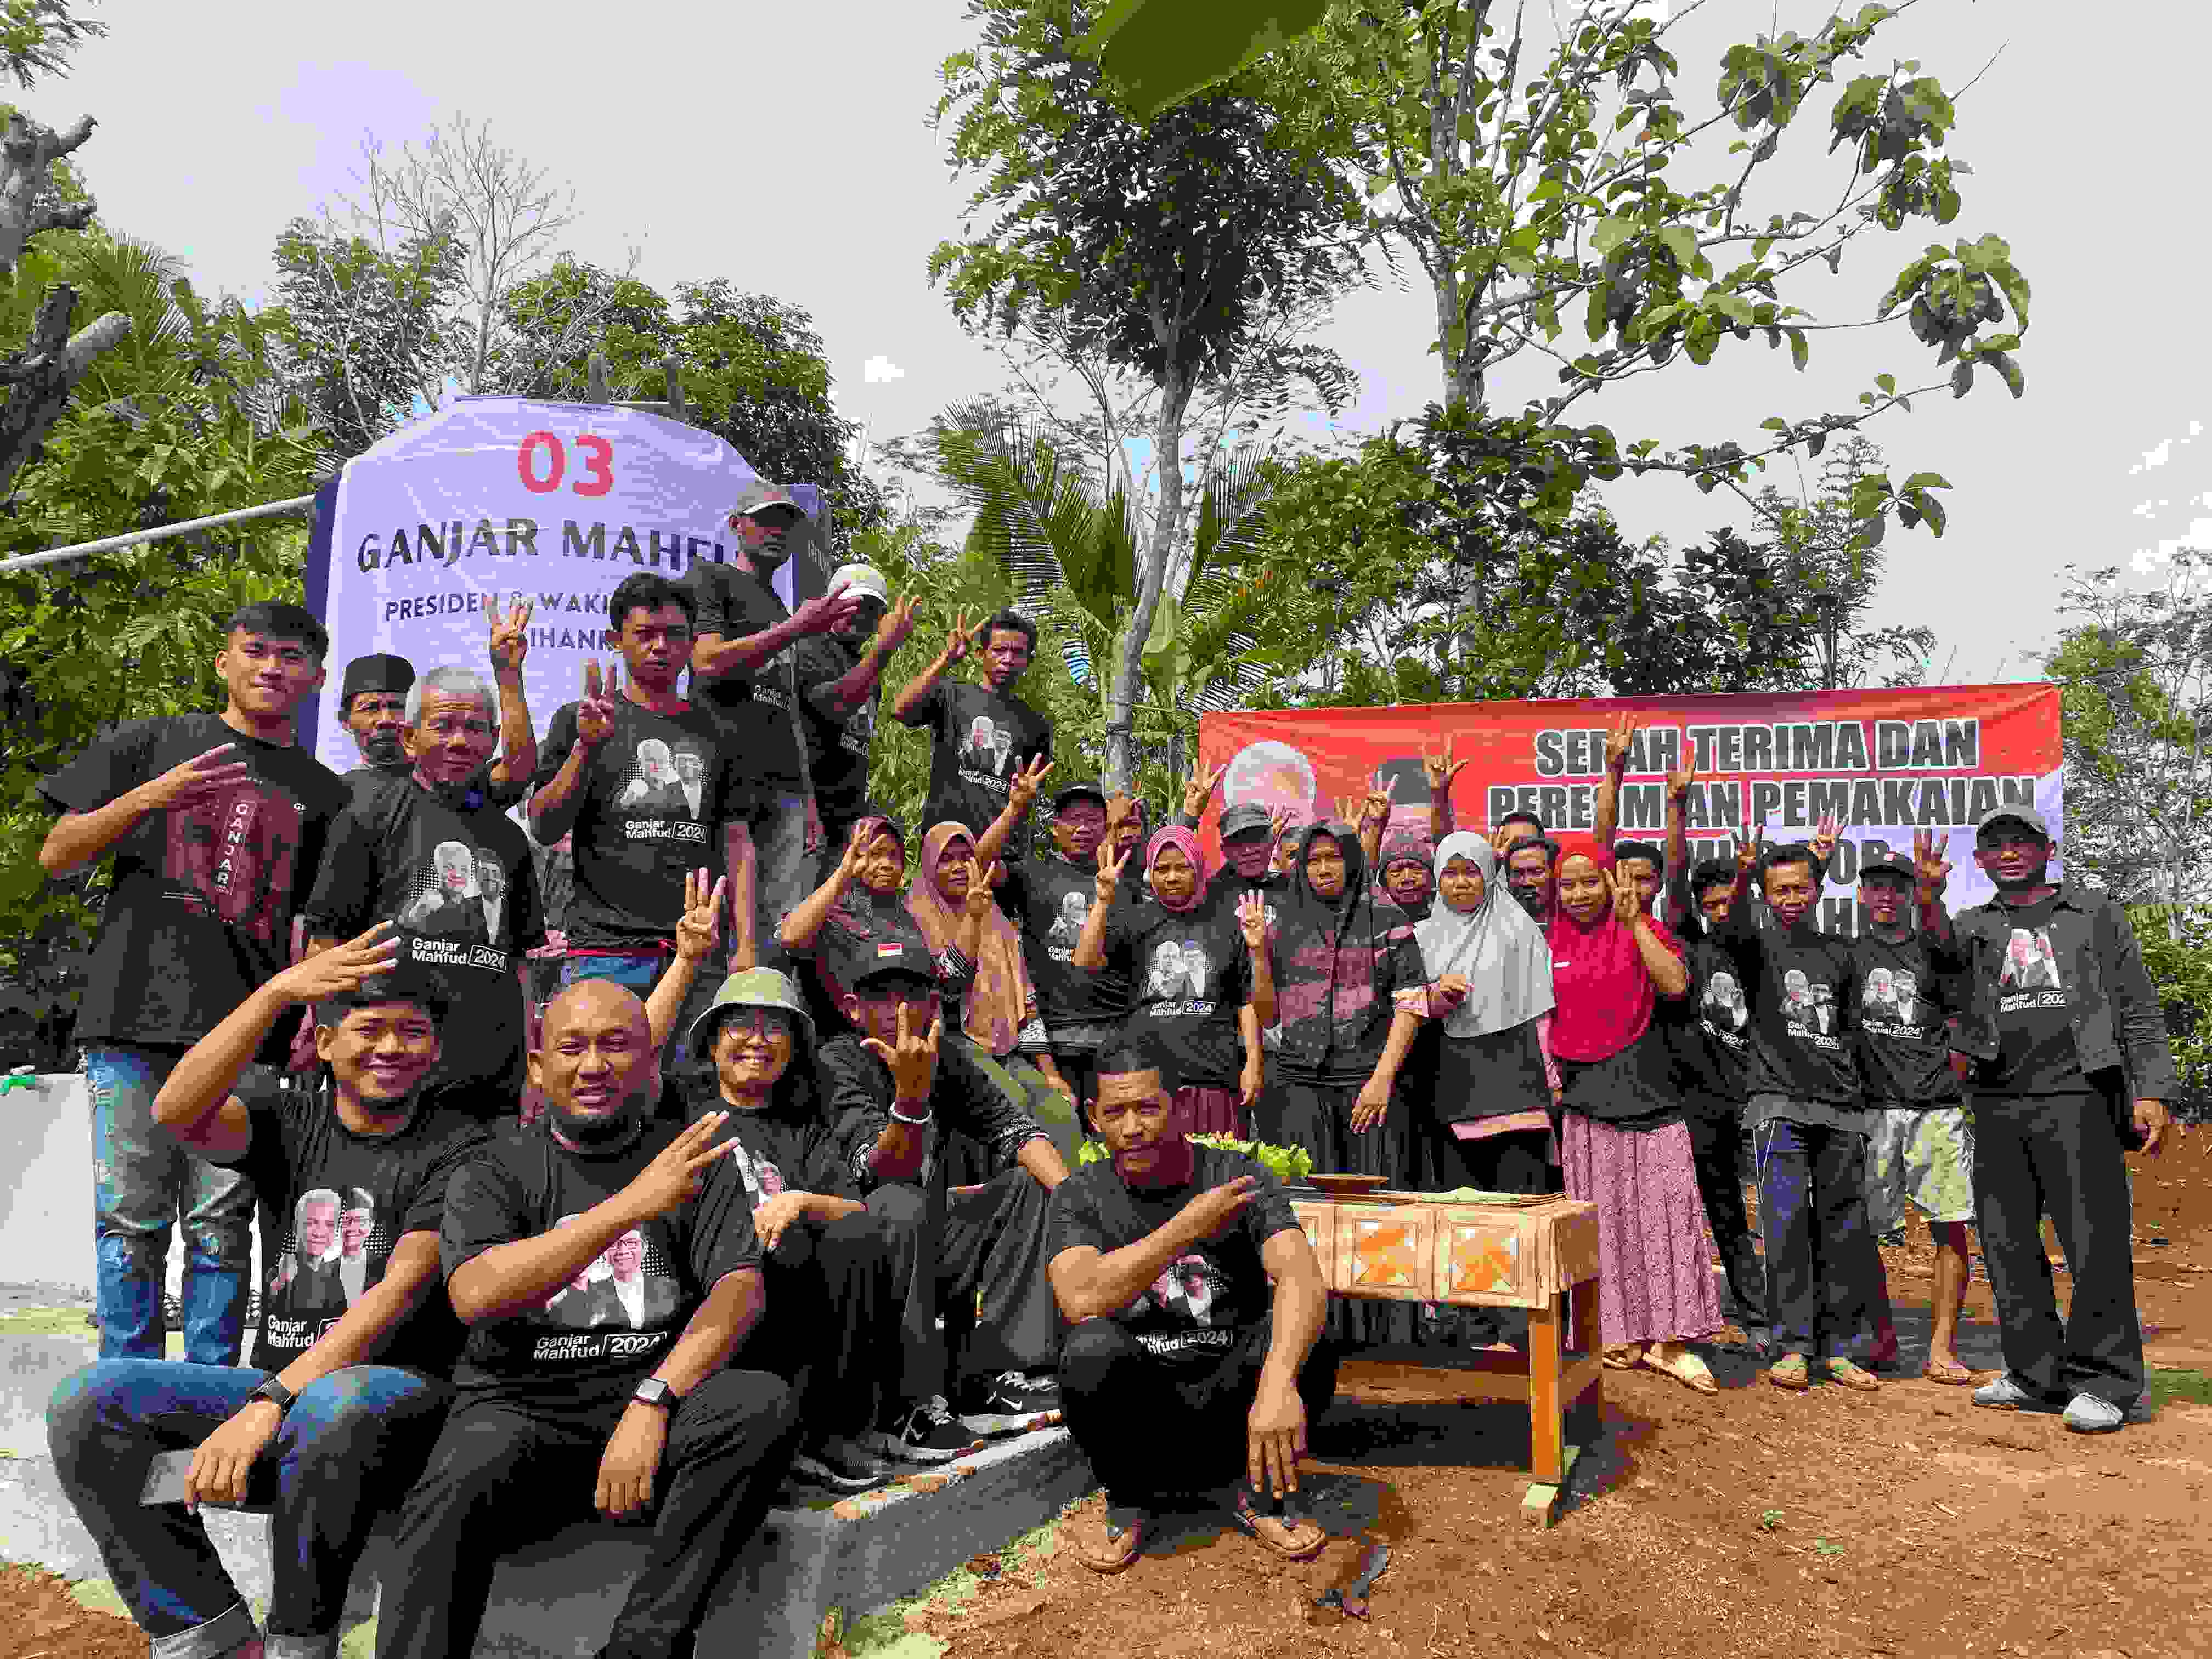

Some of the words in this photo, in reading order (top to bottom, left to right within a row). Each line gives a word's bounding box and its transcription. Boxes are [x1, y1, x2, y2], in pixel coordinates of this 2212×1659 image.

[517, 430, 614, 497] 03
[357, 517, 540, 573] GANJAR
[561, 518, 737, 571] MAHF
[538, 591, 609, 614] WAKI
[1686, 721, 1870, 772] TERIMA
[1876, 719, 1979, 771] DAN
[985, 777, 1007, 791] 2024
[1488, 781, 1742, 832] PEREMAN
[1751, 776, 2037, 830] PEMAKAIAN
[625, 818, 665, 830] Ganjar
[625, 827, 672, 839] Mahfud
[217, 803, 249, 884] GANJAR
[411, 937, 460, 953] Ganjar
[411, 949, 467, 964] Mahfud
[473, 949, 505, 969] 2024
[1048, 953, 1075, 962] Mahfu
[2000, 993, 2030, 1005] Ganjar
[2000, 999, 2037, 1013] Mahfud
[2041, 993, 2066, 1005] 202
[1186, 1002, 1212, 1013] 2024
[1891, 1025, 1920, 1037] 2024
[268, 1314, 308, 1336] Ganjar
[267, 1329, 314, 1348] Mahfud
[535, 1334, 593, 1350] Ganjar
[533, 1344, 600, 1361] Mahfud
